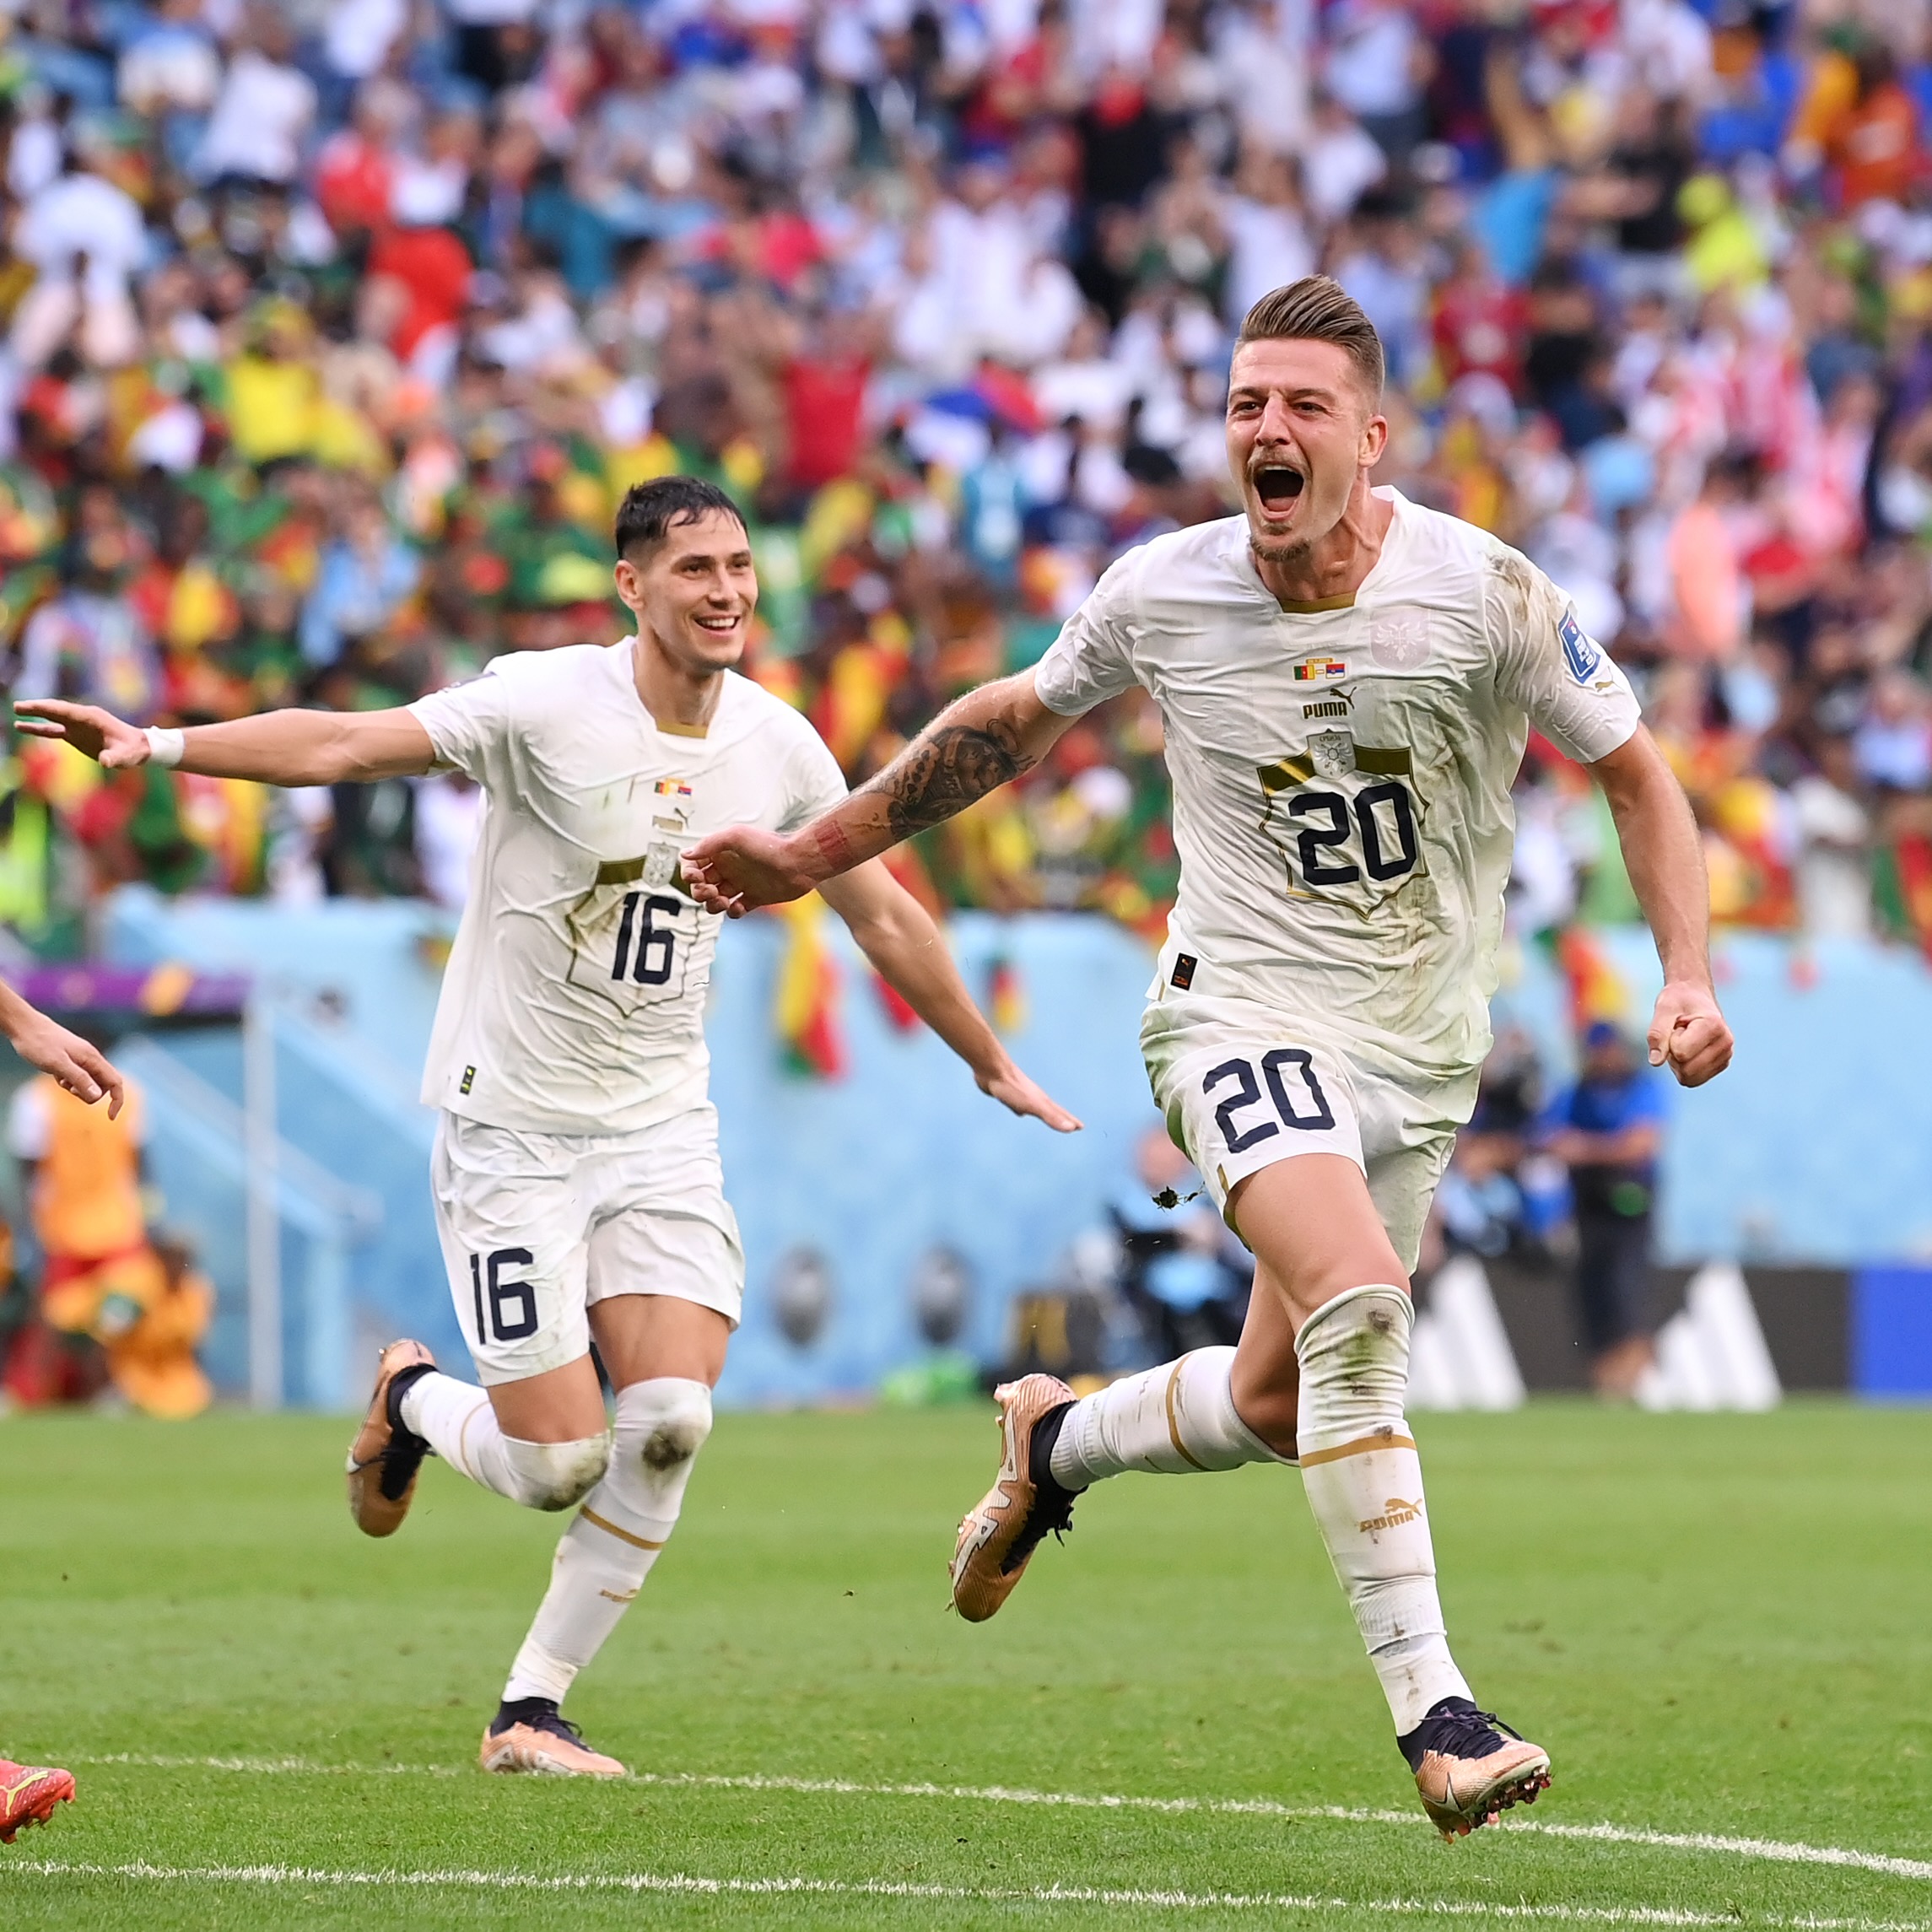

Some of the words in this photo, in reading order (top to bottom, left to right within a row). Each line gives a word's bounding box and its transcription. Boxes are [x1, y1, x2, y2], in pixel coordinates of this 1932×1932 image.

[1303, 701, 1347, 719] PUMA
[1288, 782, 1417, 885] 20
[612, 892, 681, 985] 16
[1202, 1048, 1336, 1153] 20
[470, 1248, 538, 1345] 16
[1359, 1510, 1414, 1532] PUMA
